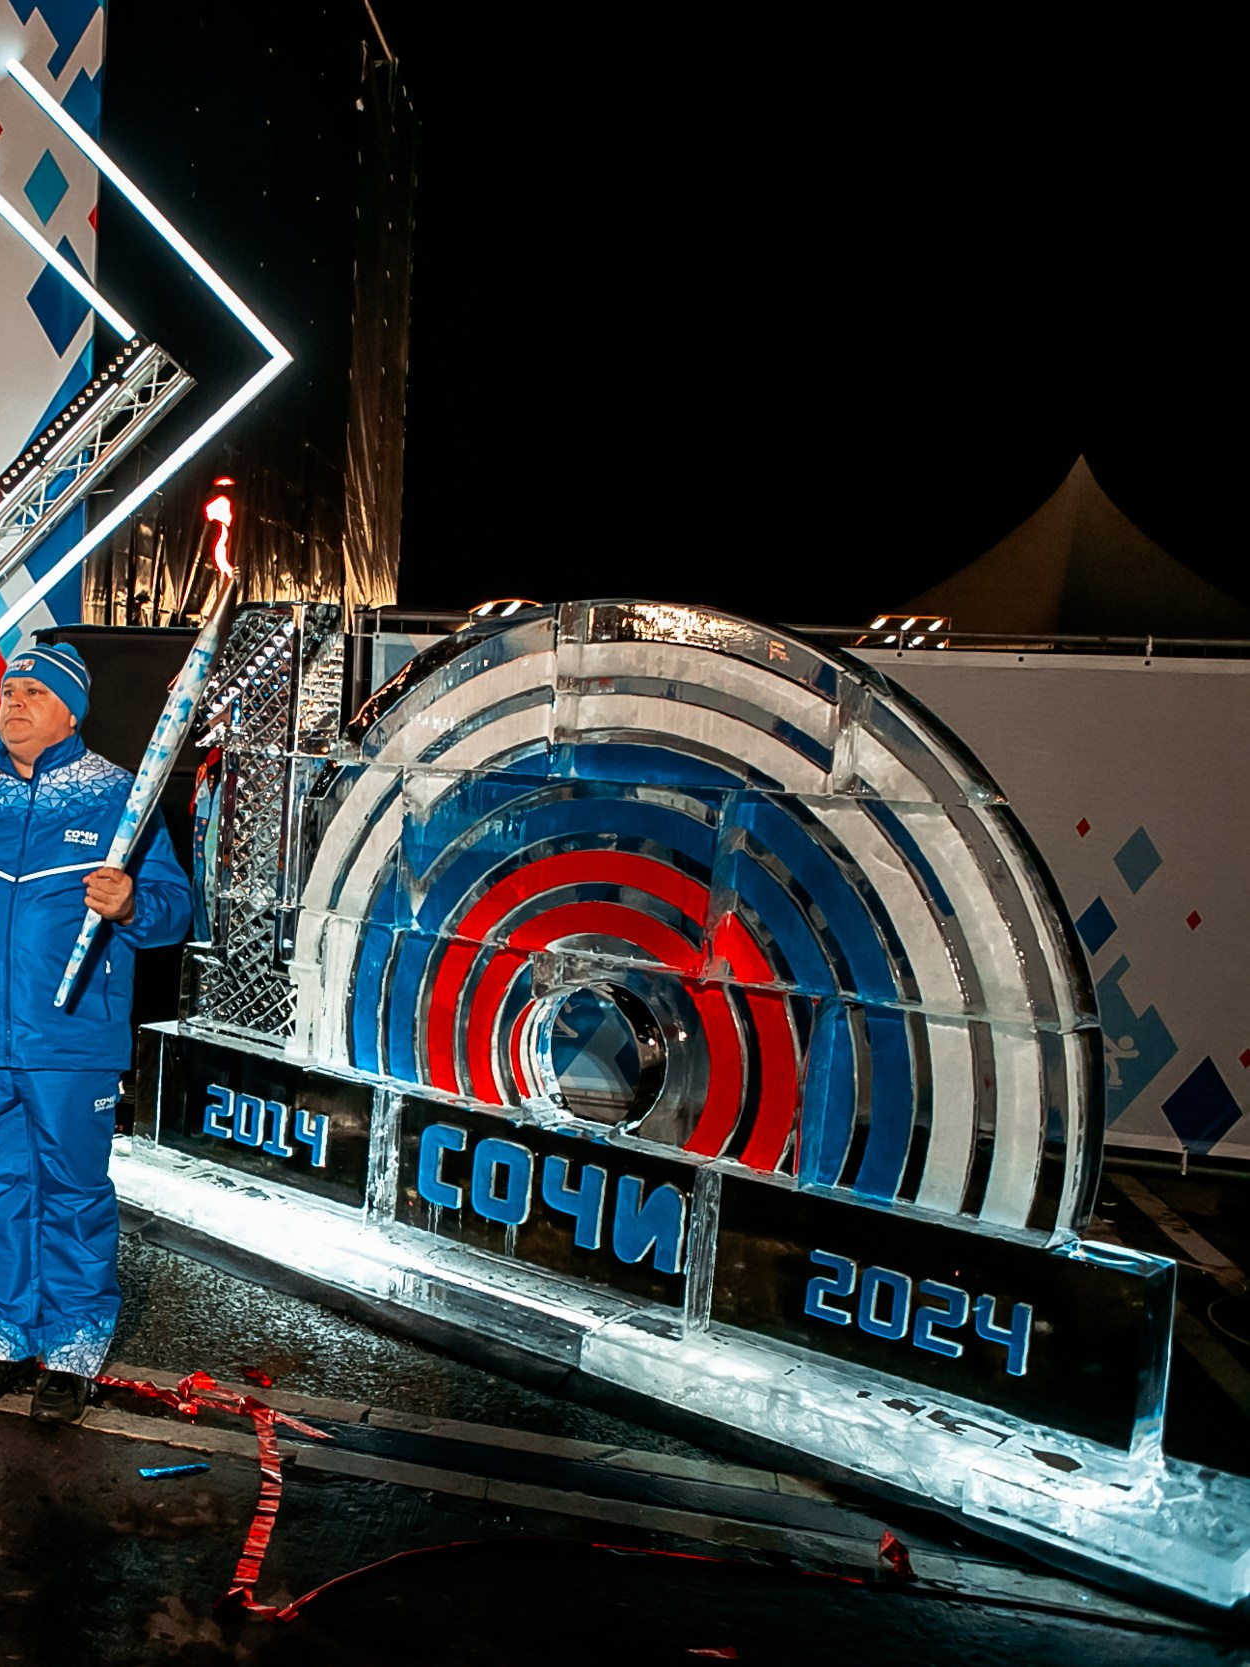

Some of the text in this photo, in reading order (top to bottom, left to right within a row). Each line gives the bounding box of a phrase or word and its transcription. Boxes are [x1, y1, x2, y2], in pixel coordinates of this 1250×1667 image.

[64, 829, 99, 841] СОЧИ
[203, 1083, 329, 1168] 2014
[418, 1123, 686, 1274] СОЧИ
[804, 1249, 1033, 1377] 2024
